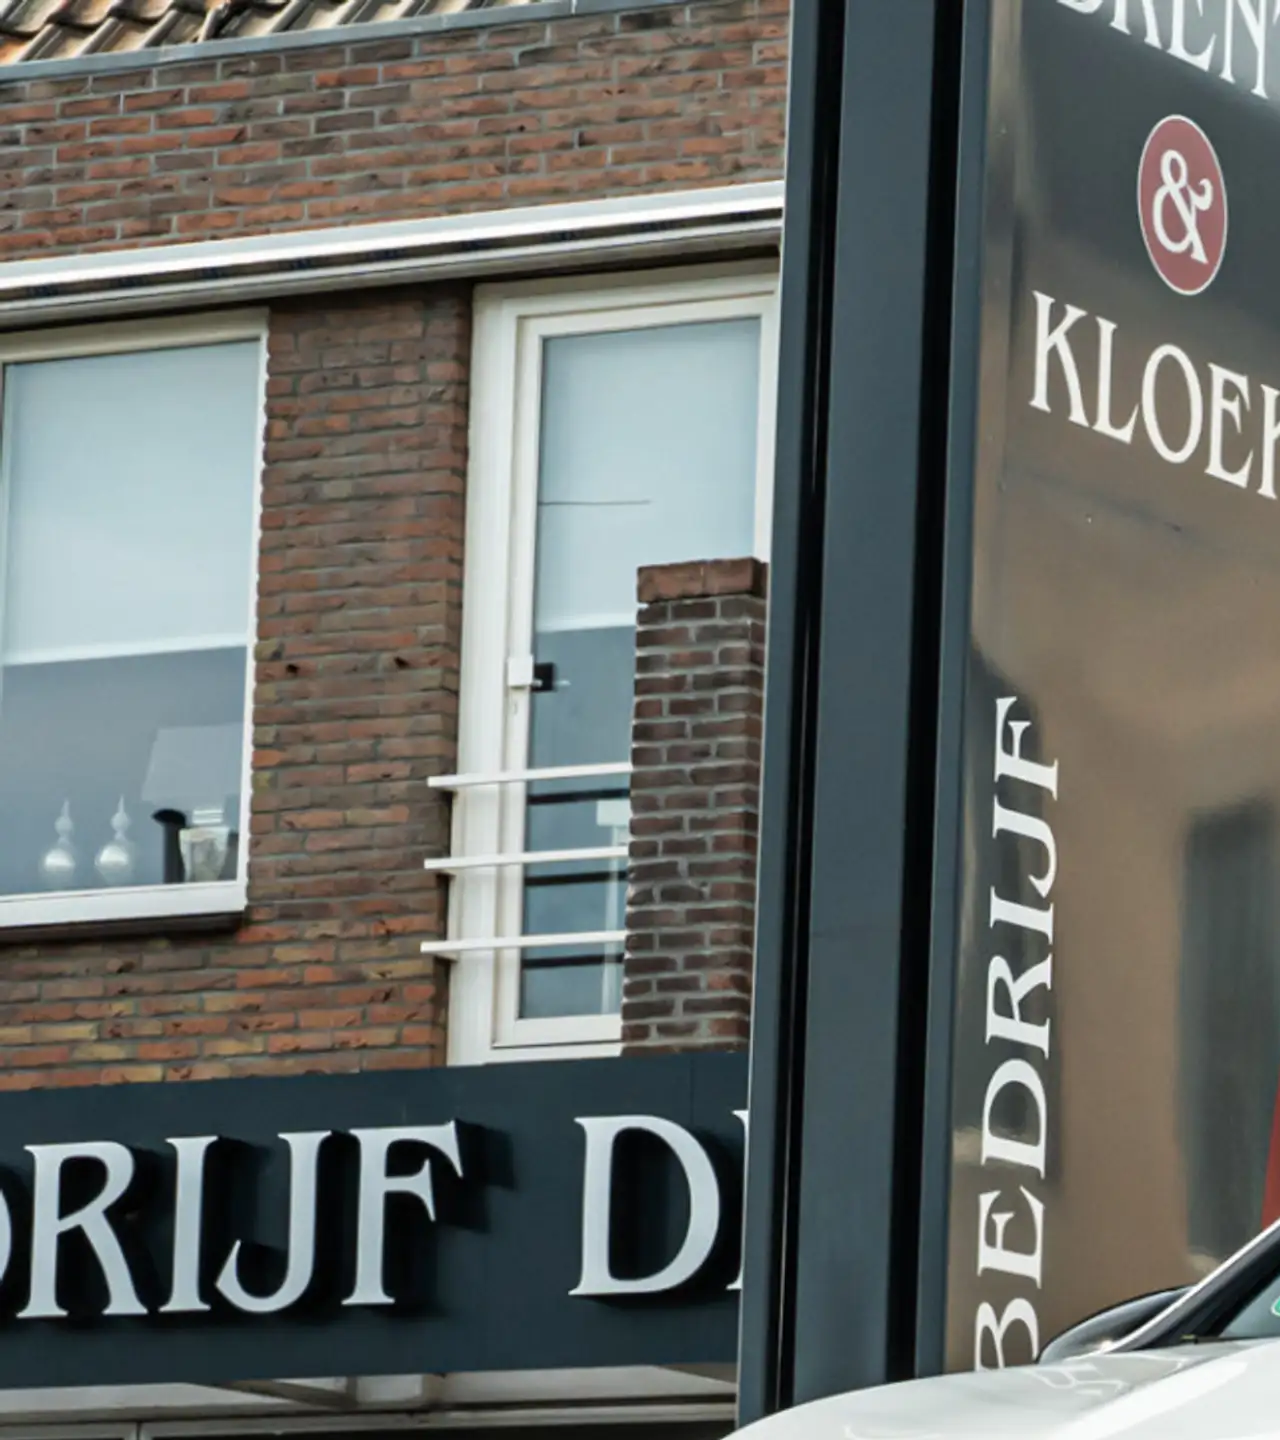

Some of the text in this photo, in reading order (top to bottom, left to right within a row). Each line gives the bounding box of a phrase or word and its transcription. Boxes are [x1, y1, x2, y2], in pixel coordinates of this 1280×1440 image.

[1152, 149, 1213, 264] &
[974, 696, 1059, 1371] BEDRIJF
[0, 1110, 749, 1319] RIJF D
